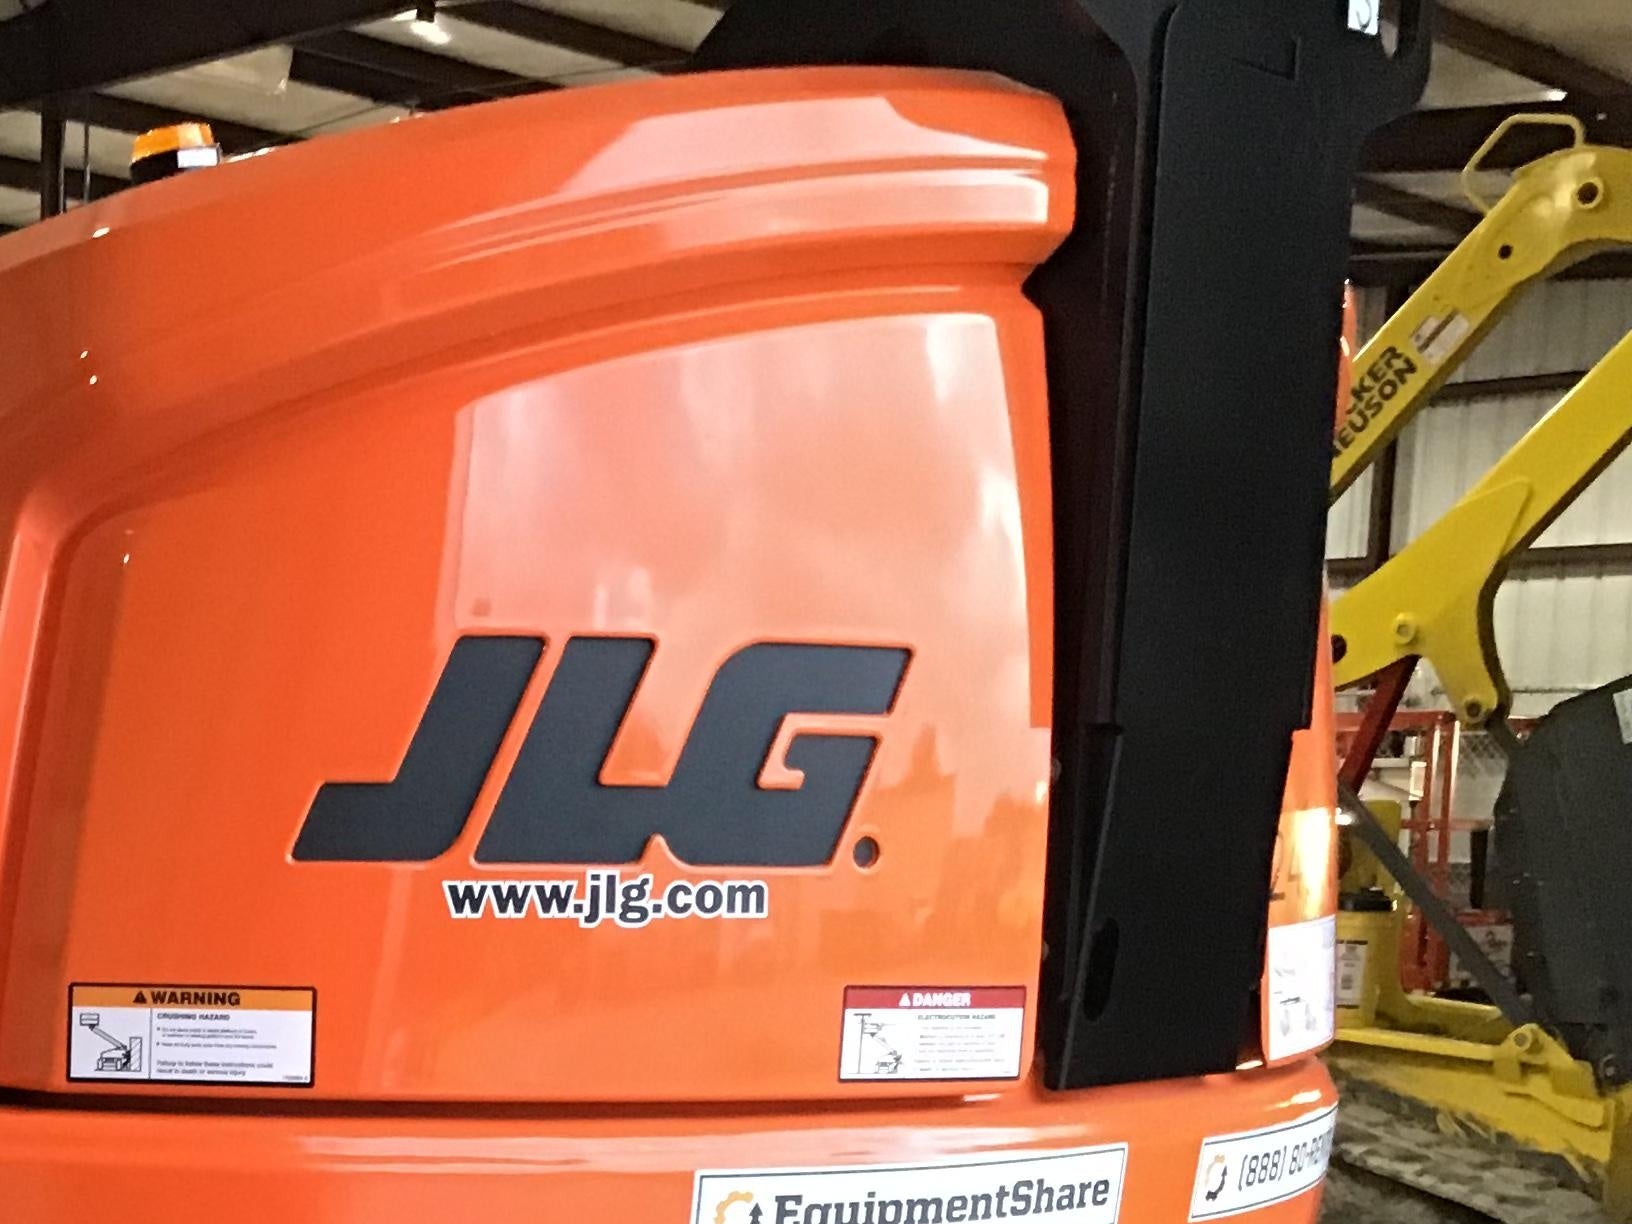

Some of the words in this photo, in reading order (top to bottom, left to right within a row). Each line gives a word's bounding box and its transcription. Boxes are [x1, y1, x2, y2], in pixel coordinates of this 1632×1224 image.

[291, 635, 913, 867] JLG
[447, 873, 766, 923] www.jlg.com
[150, 991, 241, 1006] WARNING
[912, 992, 971, 1007] DANGER
[198, 1013, 230, 1021] HAZARD
[1238, 1145, 1287, 1192] (888)
